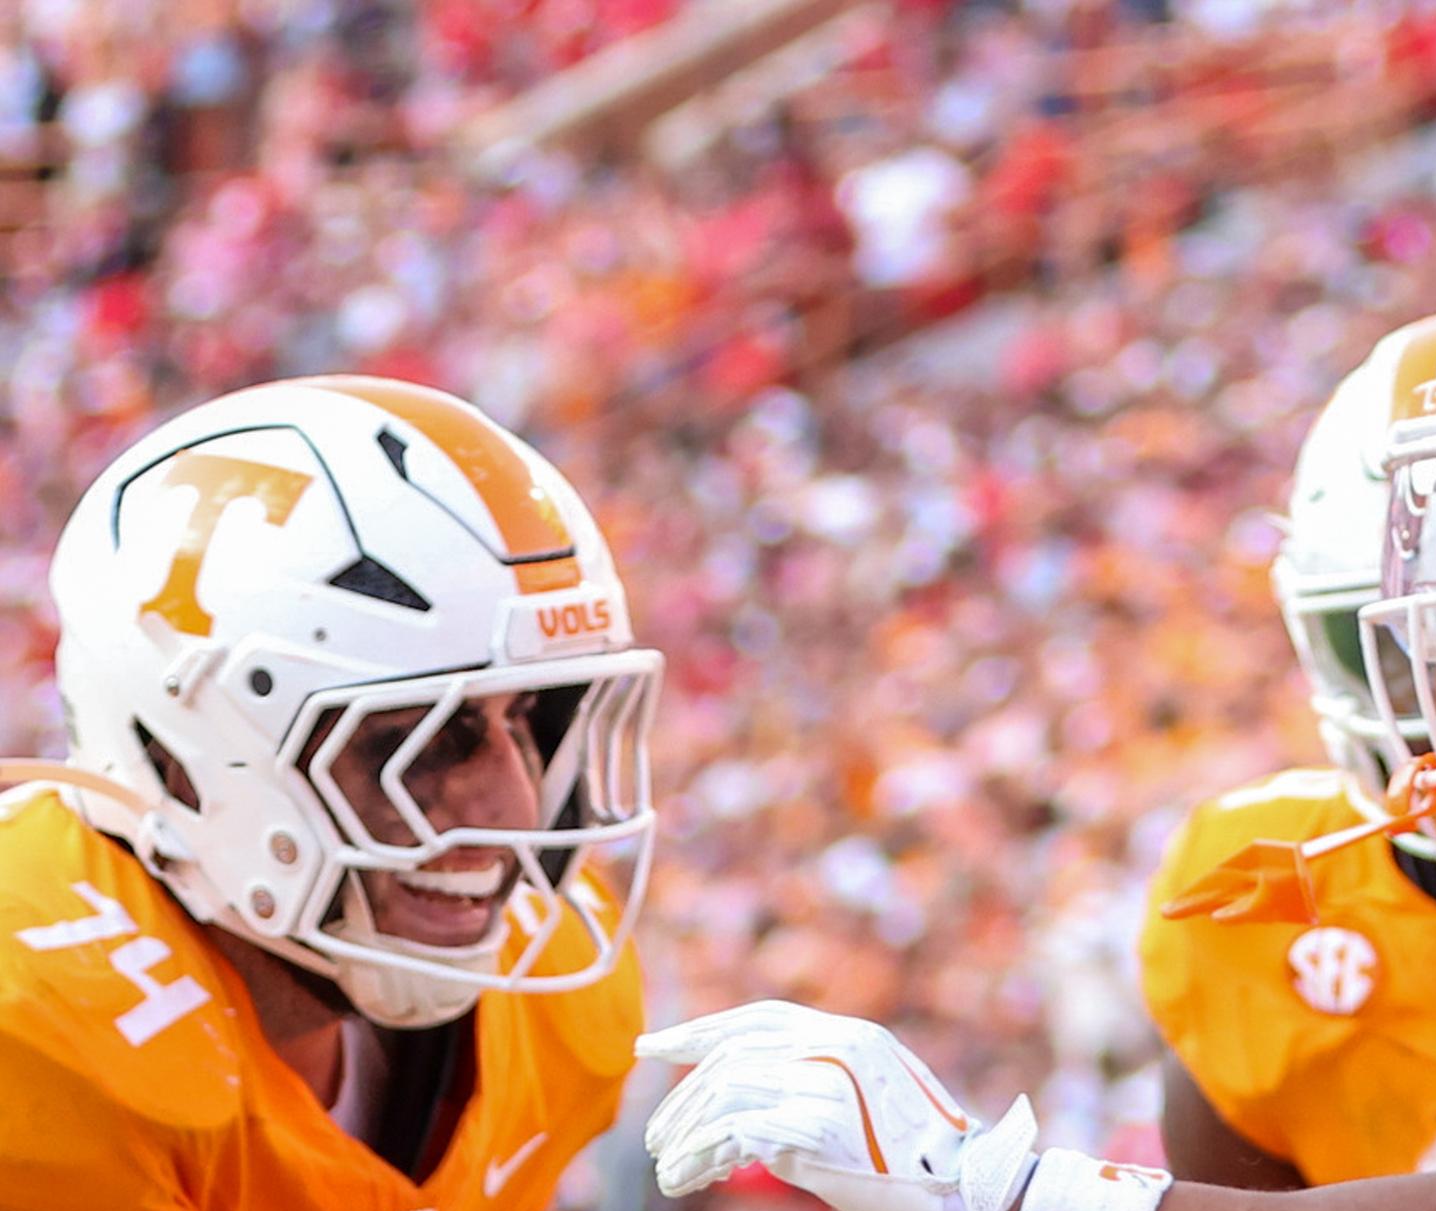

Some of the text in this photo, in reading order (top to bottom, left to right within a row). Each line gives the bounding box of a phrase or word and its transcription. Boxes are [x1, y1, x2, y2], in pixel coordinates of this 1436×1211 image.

[138, 450, 315, 638] T
[536, 599, 610, 638] VOLS
[15, 880, 212, 1047] 74
